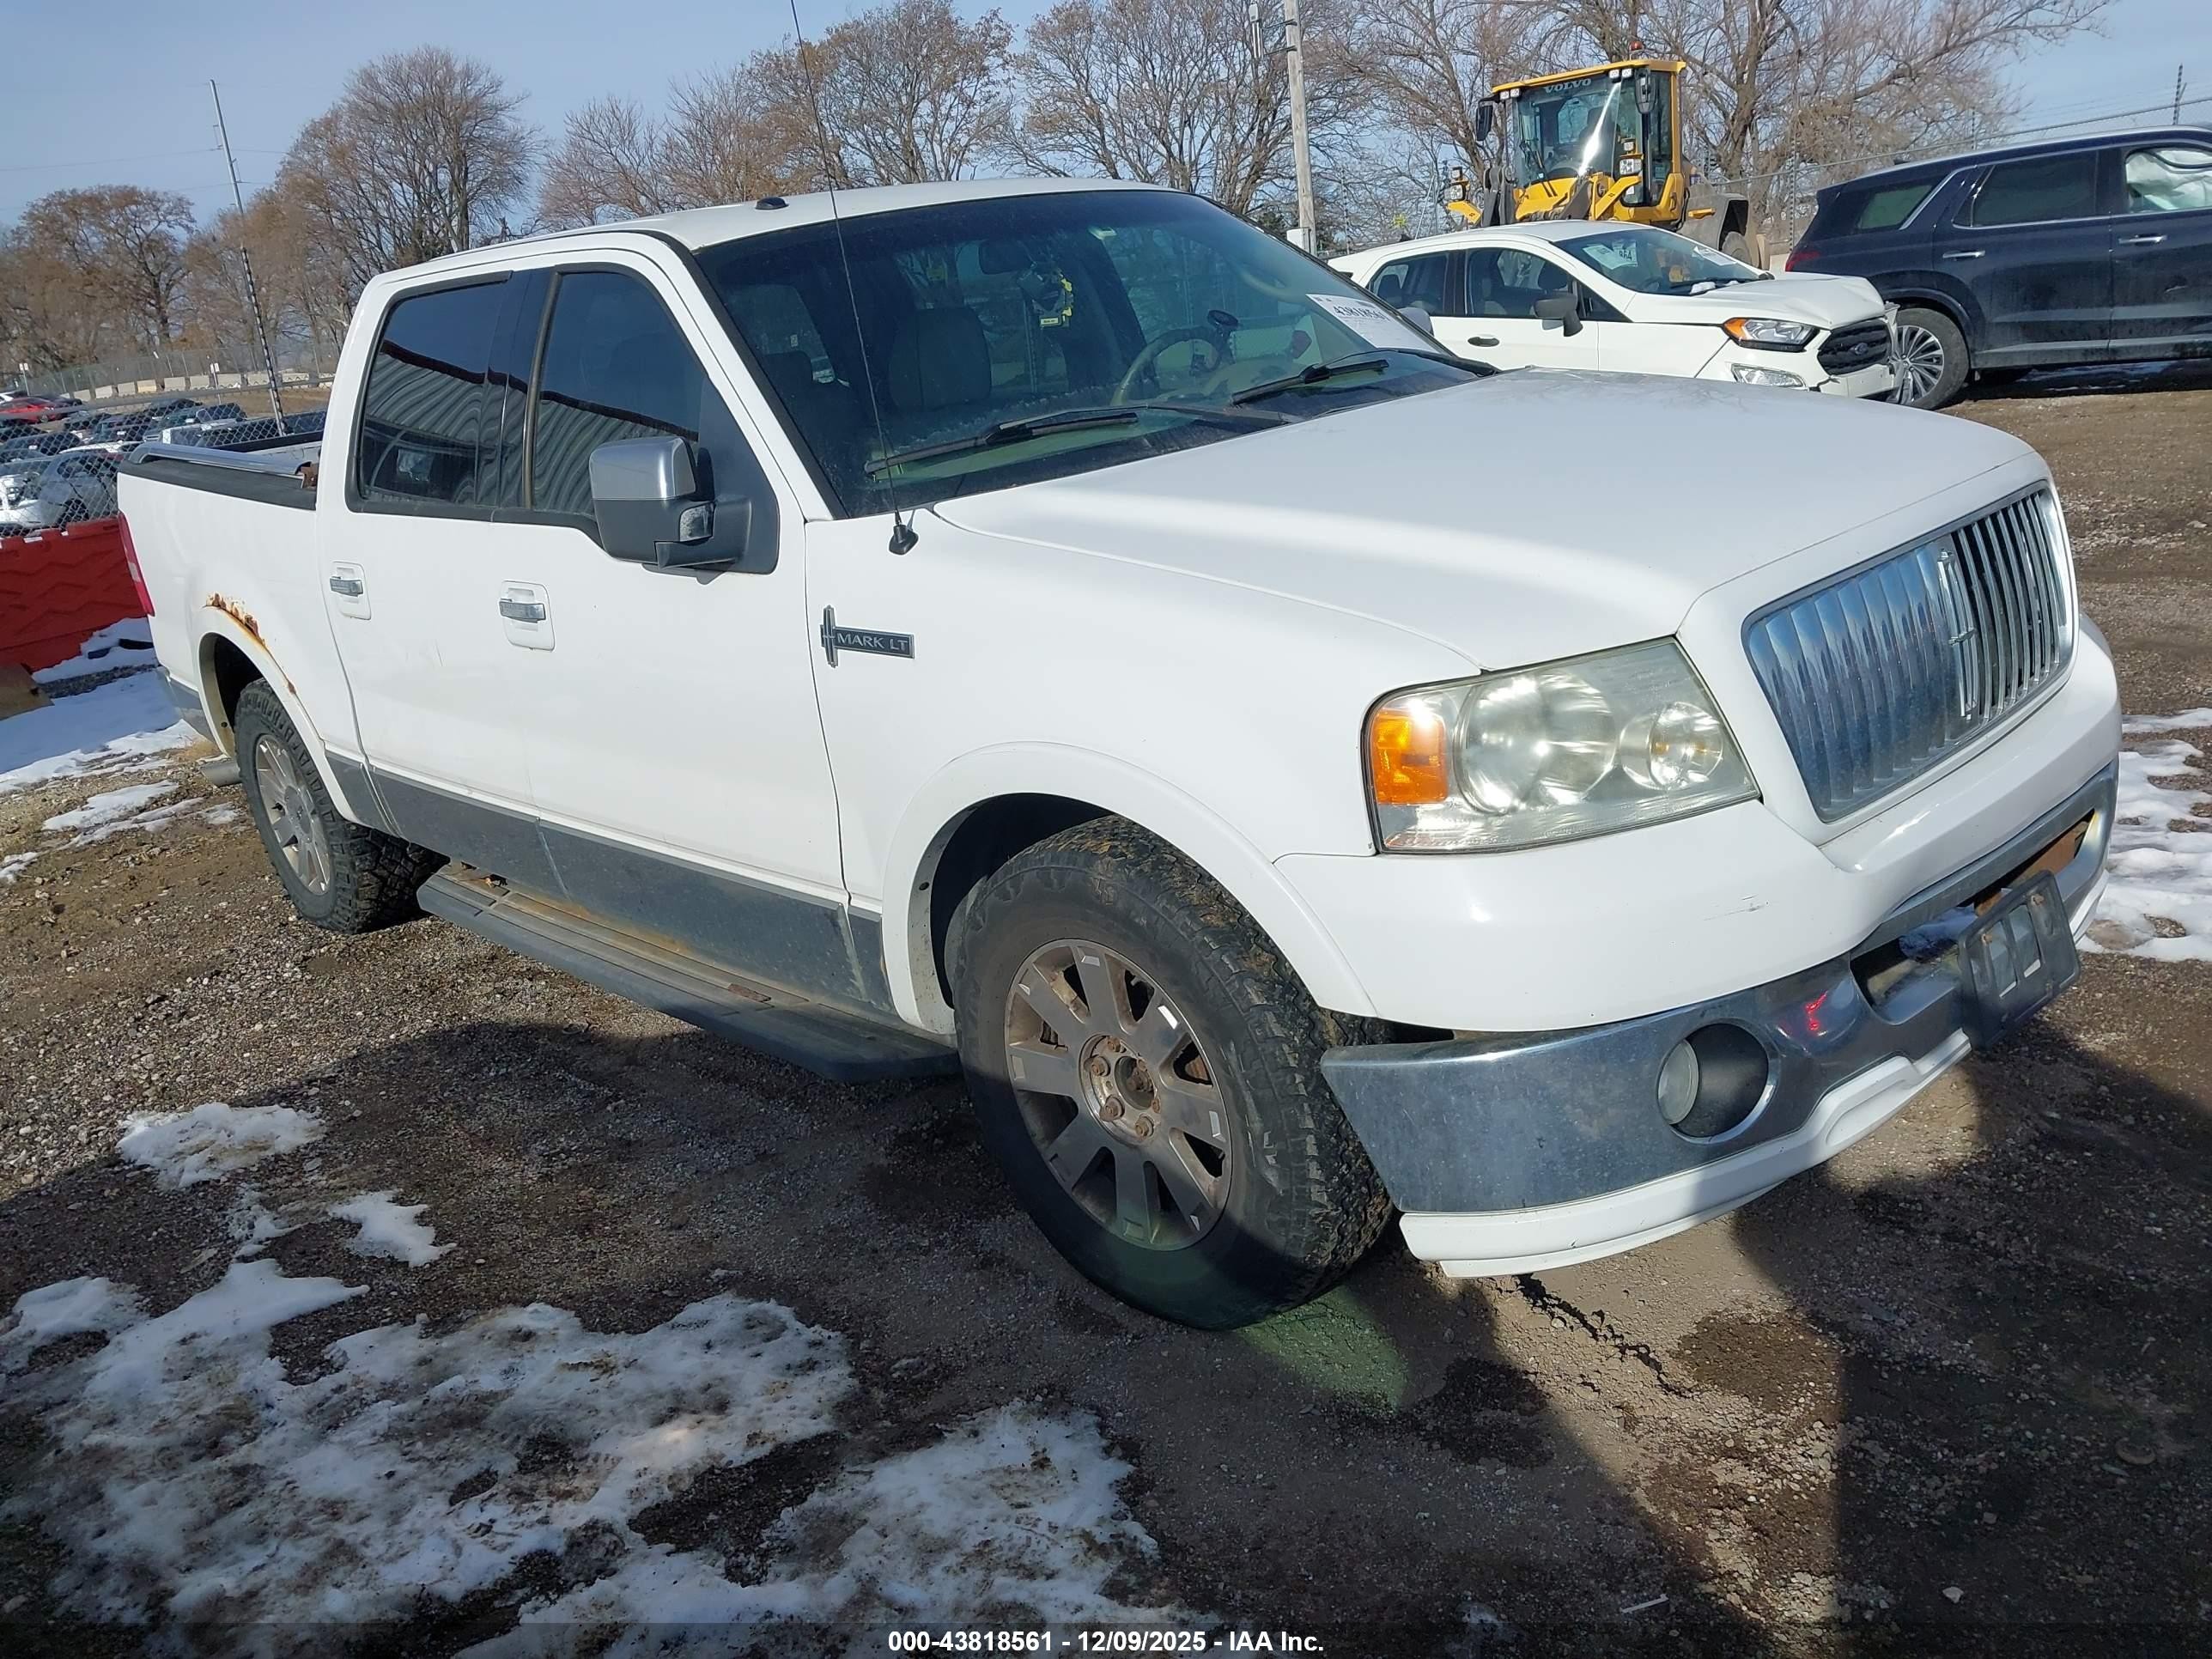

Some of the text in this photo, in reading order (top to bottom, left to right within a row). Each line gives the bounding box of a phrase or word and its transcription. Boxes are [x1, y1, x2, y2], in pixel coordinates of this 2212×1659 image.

[1544, 78, 1591, 94] VOLVO
[837, 633, 908, 652] MARK LT
